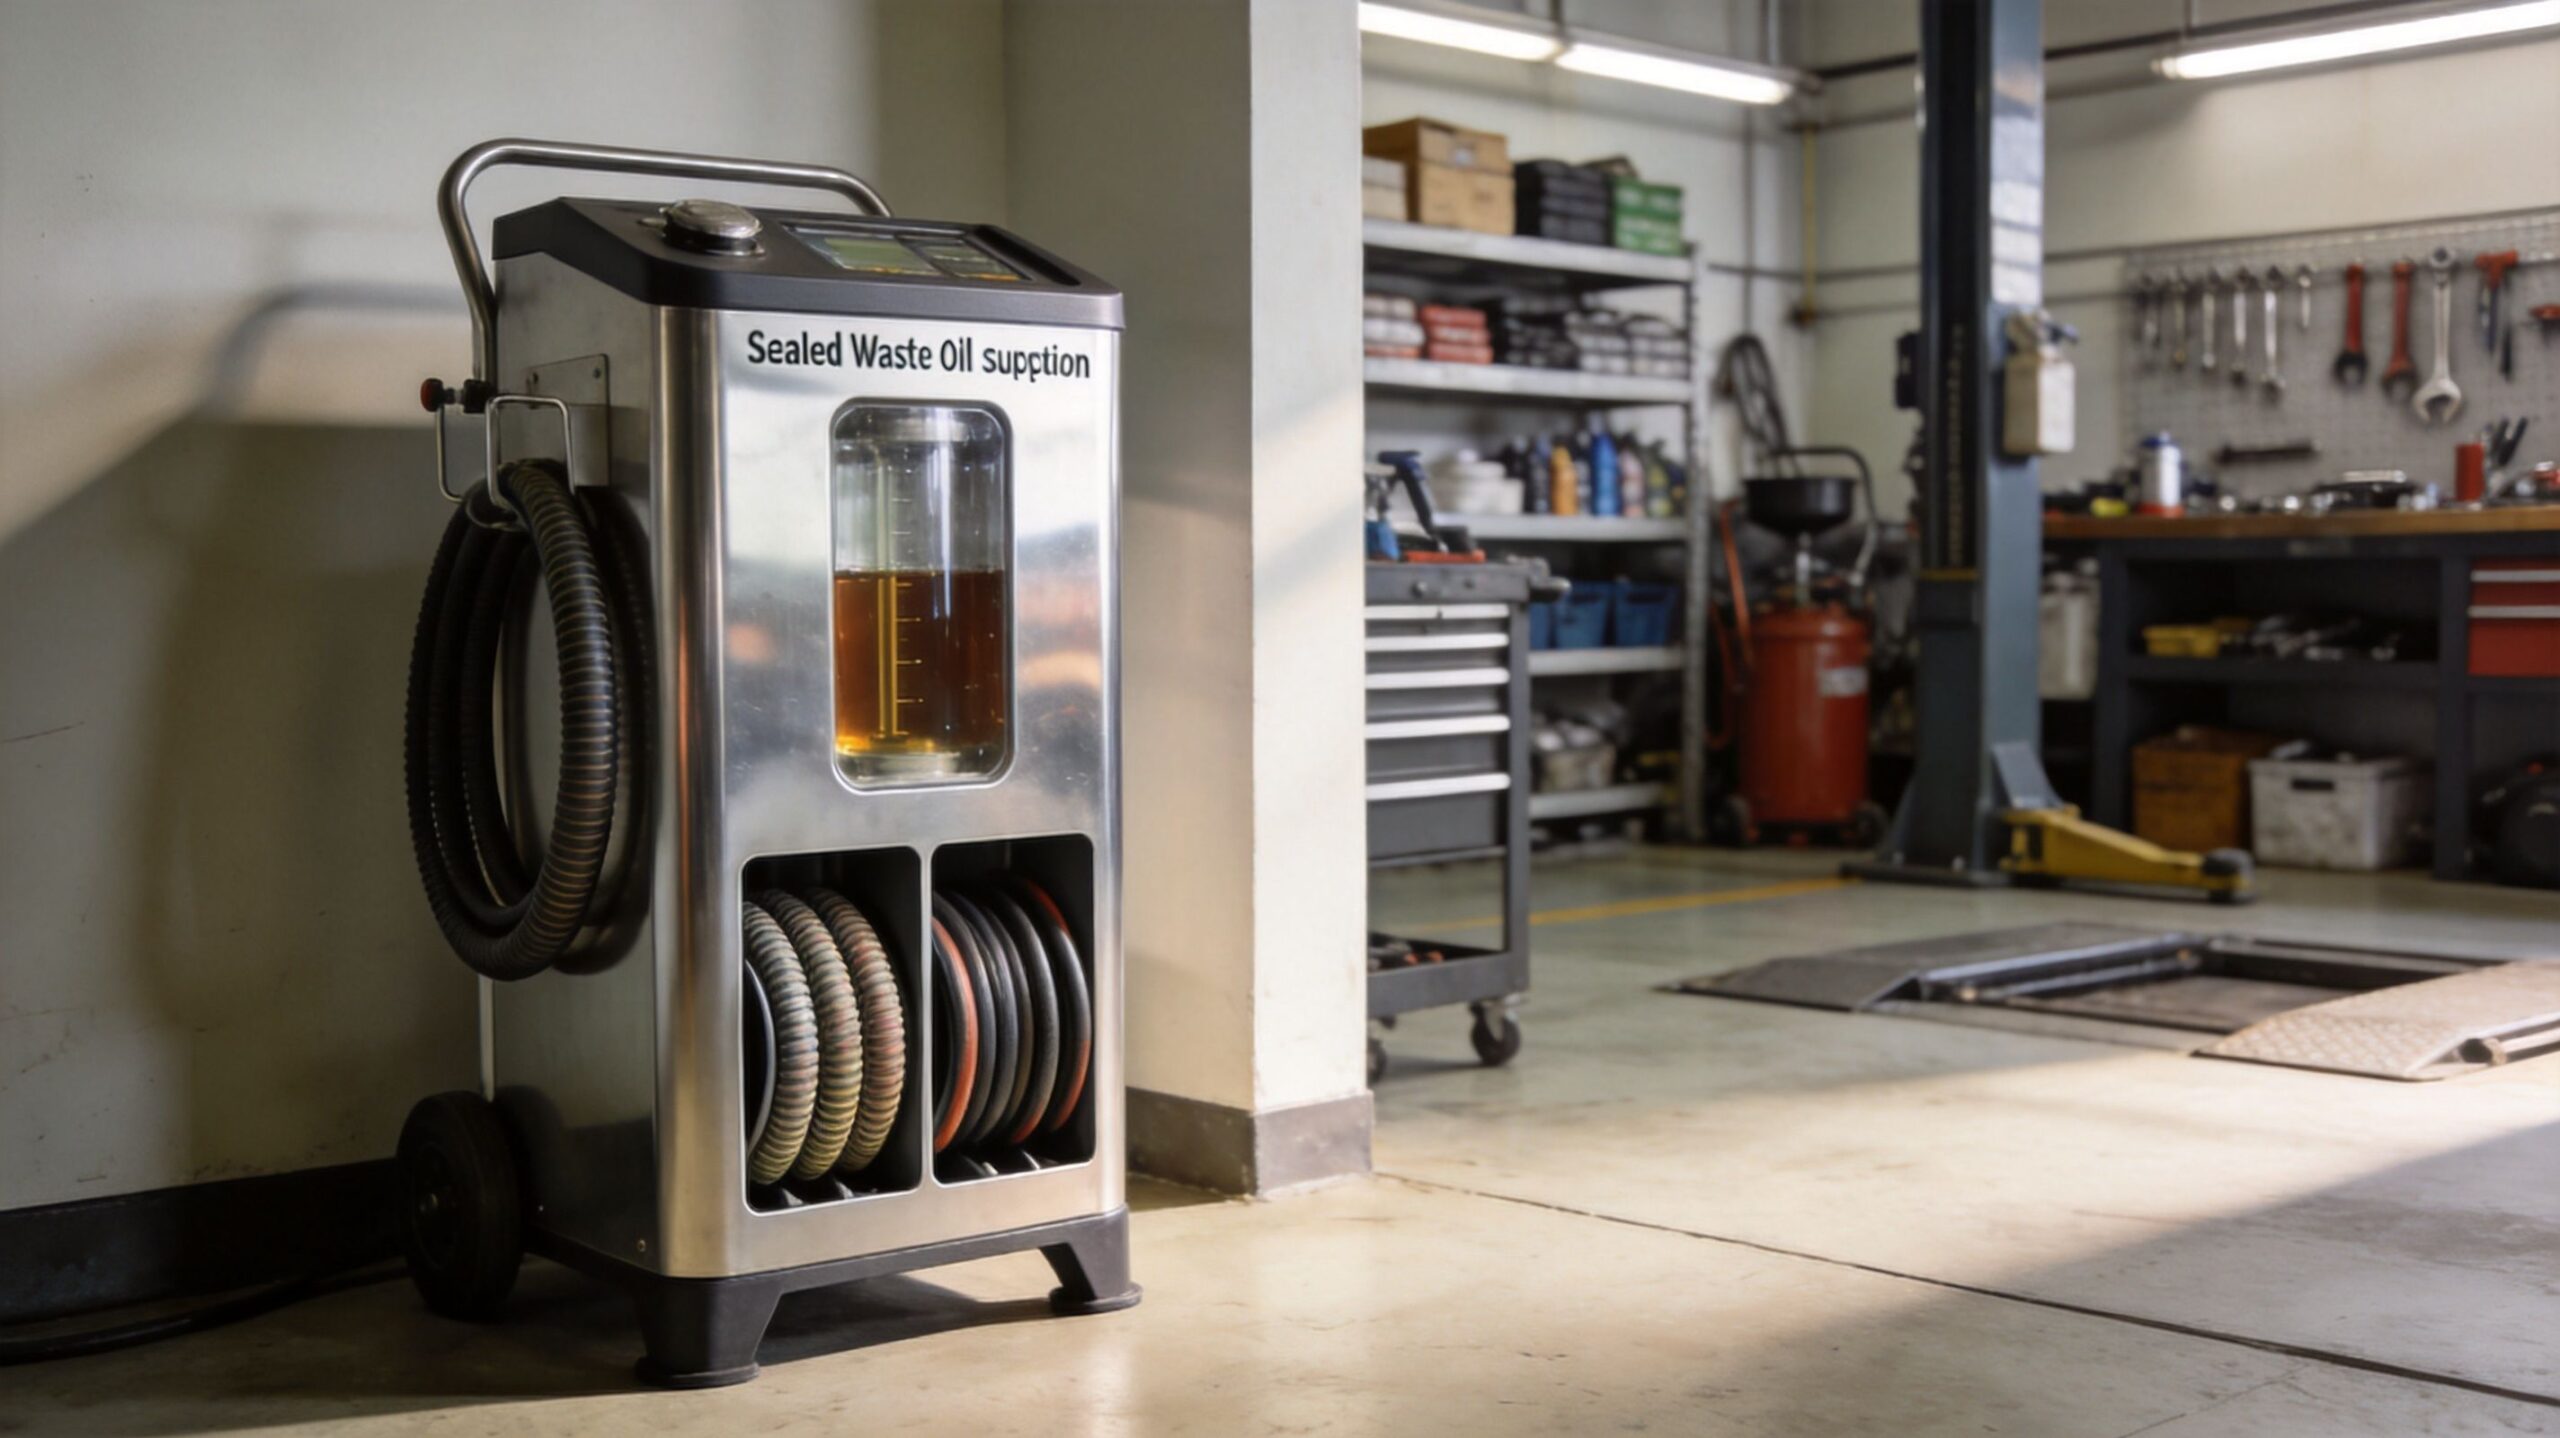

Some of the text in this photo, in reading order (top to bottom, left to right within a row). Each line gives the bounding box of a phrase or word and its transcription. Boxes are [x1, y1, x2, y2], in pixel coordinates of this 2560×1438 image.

[748, 330, 842, 366] Sealed
[850, 333, 932, 370] Waste
[940, 337, 972, 372] Oil
